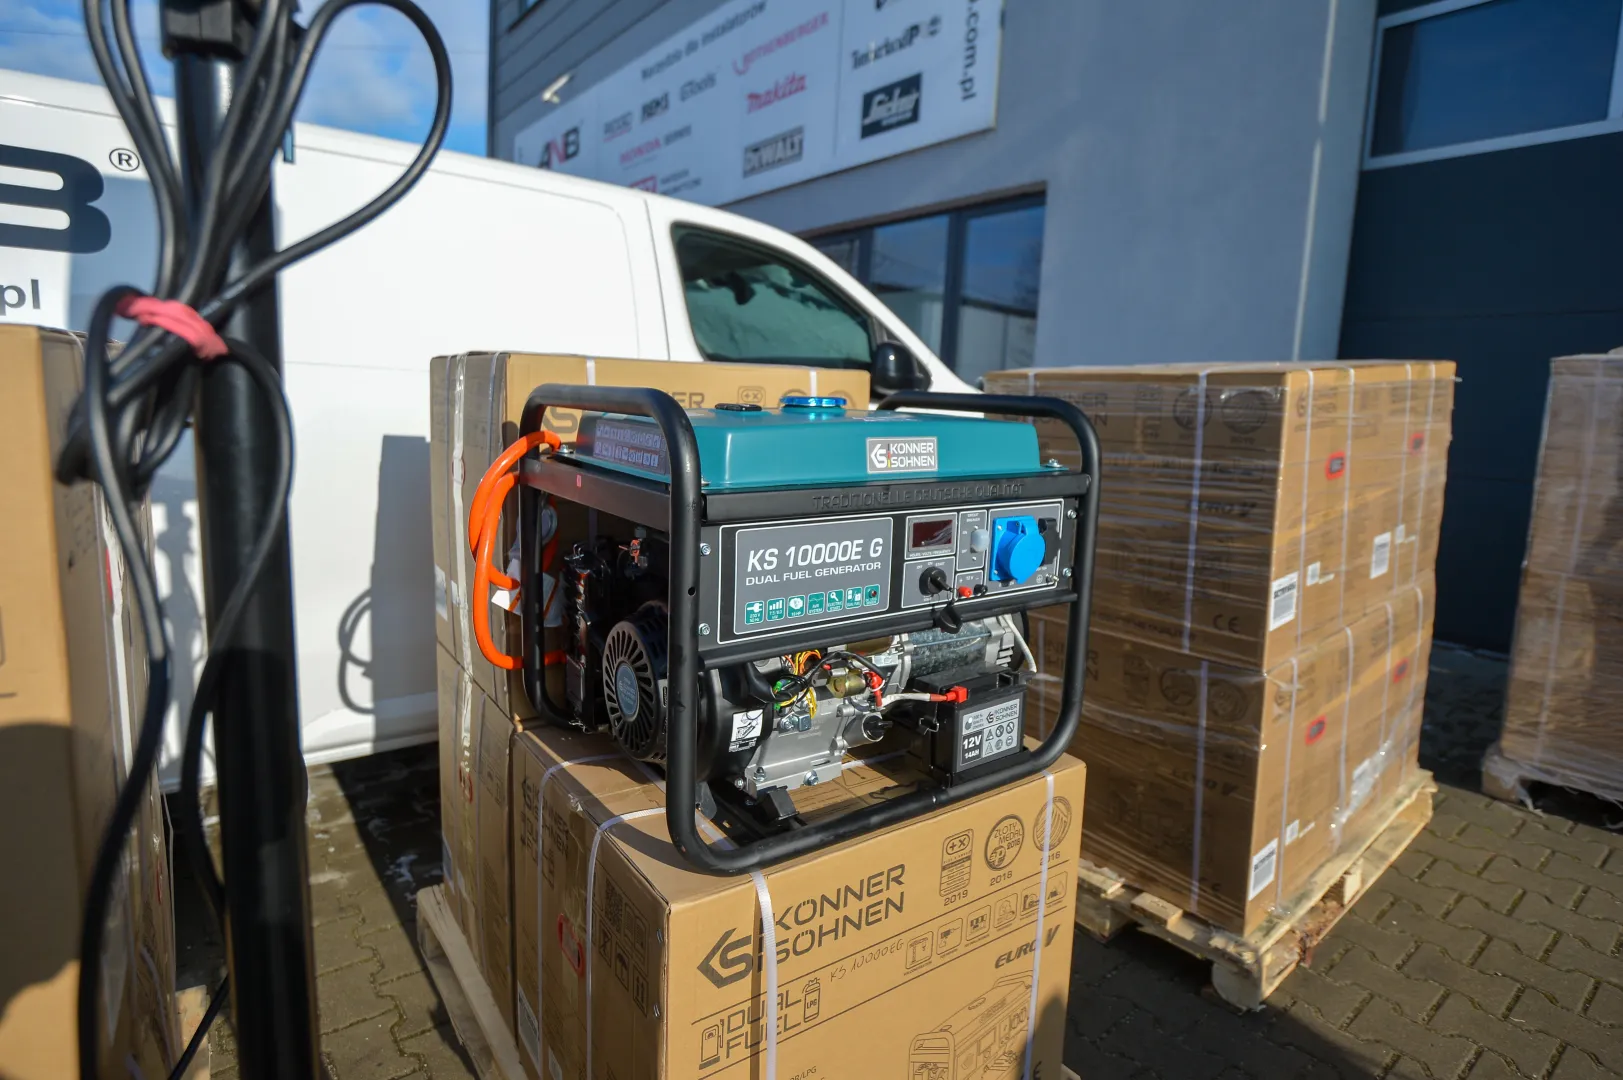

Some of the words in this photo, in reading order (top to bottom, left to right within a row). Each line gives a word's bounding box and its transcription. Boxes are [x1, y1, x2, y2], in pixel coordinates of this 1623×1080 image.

[747, 548, 778, 573] KS
[785, 538, 863, 568] 10000E
[869, 537, 884, 558] G
[745, 571, 781, 586] DUAL
[783, 567, 812, 581] FUEL
[815, 561, 882, 578] GENERATOR
[963, 735, 982, 749] 12V
[989, 870, 1013, 887] 2018
[943, 889, 969, 907] 2019
[1044, 924, 1061, 947] V
[806, 998, 818, 1010] LPG
